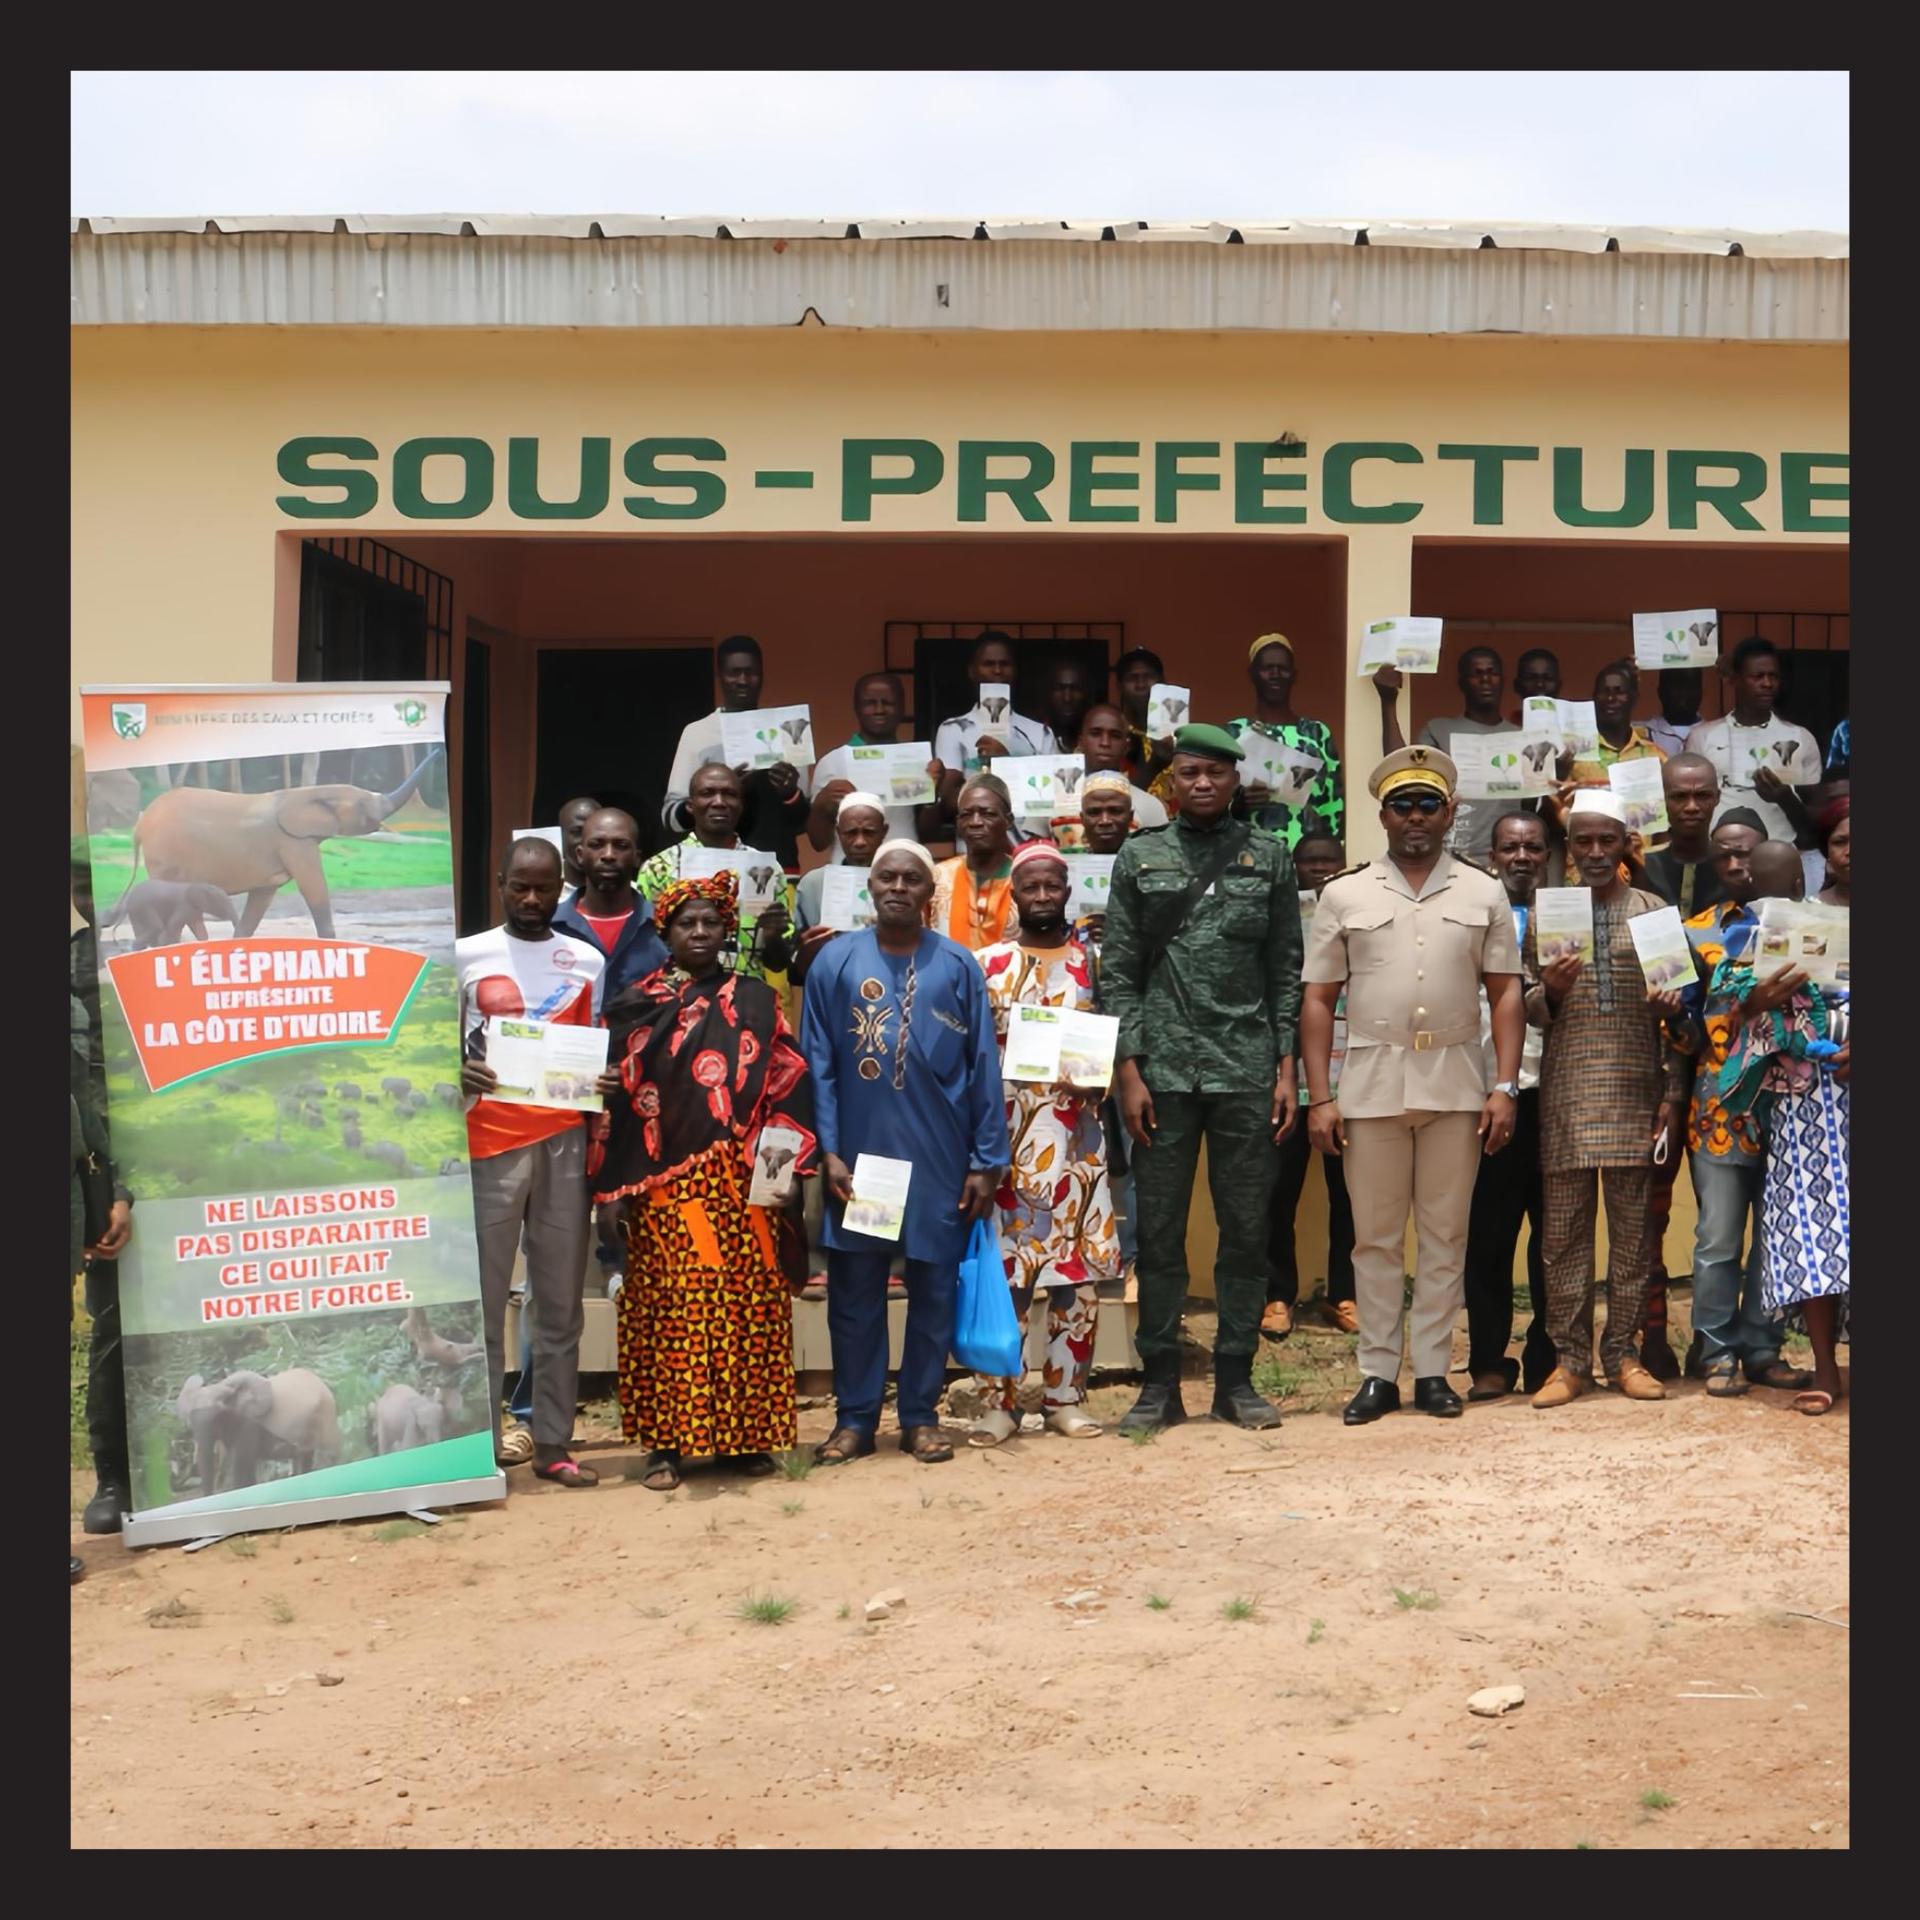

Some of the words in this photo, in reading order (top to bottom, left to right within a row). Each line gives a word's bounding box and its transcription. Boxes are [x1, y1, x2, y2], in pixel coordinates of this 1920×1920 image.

[232, 712, 258, 724] DES
[303, 712, 319, 724] ET
[190, 948, 371, 987] ÉLÉPHANT
[205, 985, 334, 1011] REPRÉSENTE
[144, 1022, 180, 1048] LA
[185, 1015, 258, 1044] CÔTE
[206, 1201, 246, 1224] NE
[255, 1188, 396, 1220] LAISSONS
[178, 1234, 232, 1259] PAS
[241, 1216, 428, 1252] DISPARAITRE
[221, 1264, 259, 1286] CE
[268, 1257, 319, 1281] QUI
[329, 1251, 390, 1276] FAIT
[203, 1291, 300, 1321] NOTRE
[310, 1281, 412, 1309] FORCE.
